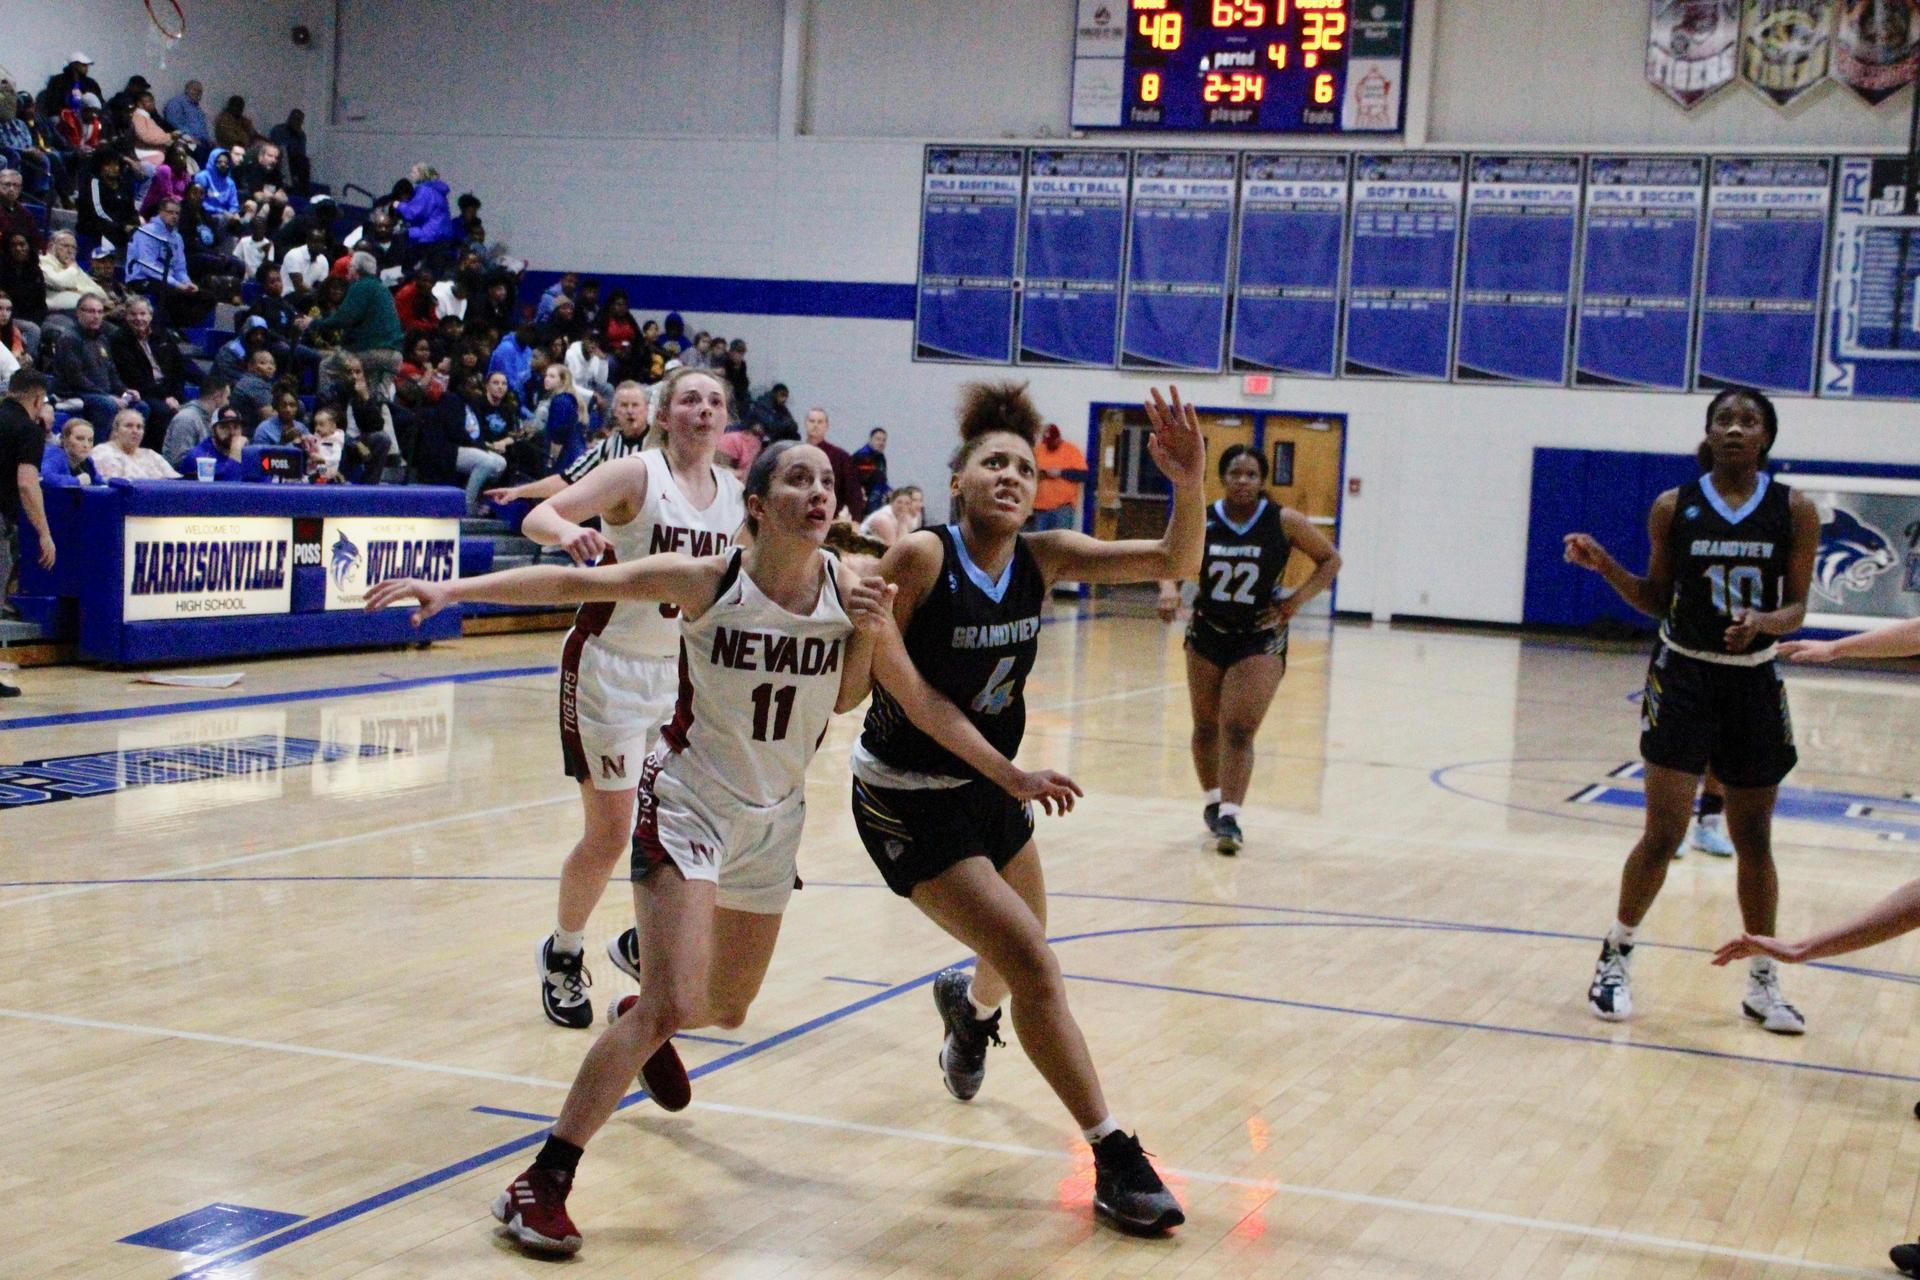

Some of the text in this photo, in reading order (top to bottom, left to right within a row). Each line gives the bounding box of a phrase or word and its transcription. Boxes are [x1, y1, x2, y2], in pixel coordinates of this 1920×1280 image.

[1139, 13, 1181, 50] 48
[1301, 13, 1345, 50] 32
[1268, 44, 1287, 69] 4
[1141, 73, 1159, 102] 8
[1204, 75, 1263, 102] 2-34
[1315, 74, 1333, 103] 6
[1033, 182, 1121, 194] VOLLEYBALL
[1249, 186, 1340, 198] GIRLS GOLF
[1366, 186, 1447, 199] SOFTBALL
[185, 525, 228, 534] WELCOME
[649, 523, 733, 558] NEVAD
[131, 540, 288, 596] HARRISONVILLE
[294, 543, 321, 565] POSS
[366, 539, 455, 587] WILDCATS
[1208, 561, 1260, 605] 22
[1704, 565, 1763, 624] 10
[176, 599, 246, 613] HIGH SCHOOL
[710, 626, 840, 676] NEVADA
[970, 656, 1017, 715] 4
[563, 670, 577, 734] TIGERS
[751, 683, 796, 742] 11
[601, 755, 626, 779] N
[689, 840, 715, 866] N
